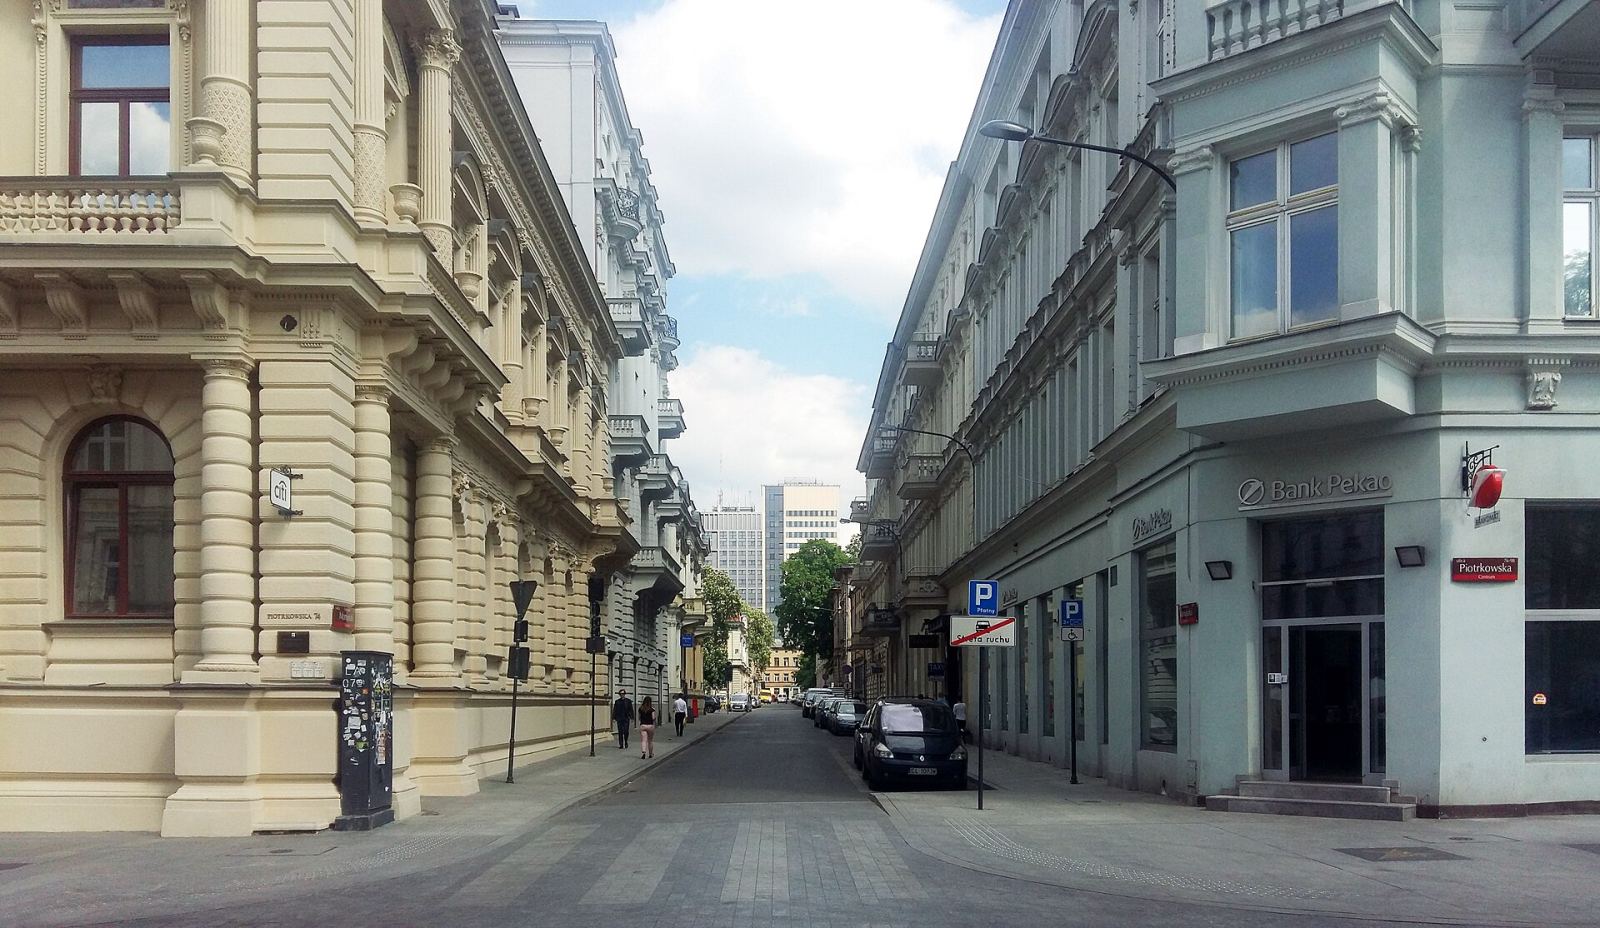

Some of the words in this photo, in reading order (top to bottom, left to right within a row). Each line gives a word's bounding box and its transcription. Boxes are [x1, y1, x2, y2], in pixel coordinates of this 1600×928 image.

[274, 480, 287, 502] citi
[1271, 476, 1323, 501] Bank
[1327, 473, 1393, 495] Pekao
[1459, 562, 1512, 573] Piotrkowska
[976, 583, 993, 606] P
[1066, 601, 1079, 619] P
[986, 635, 1010, 643] ruchu
